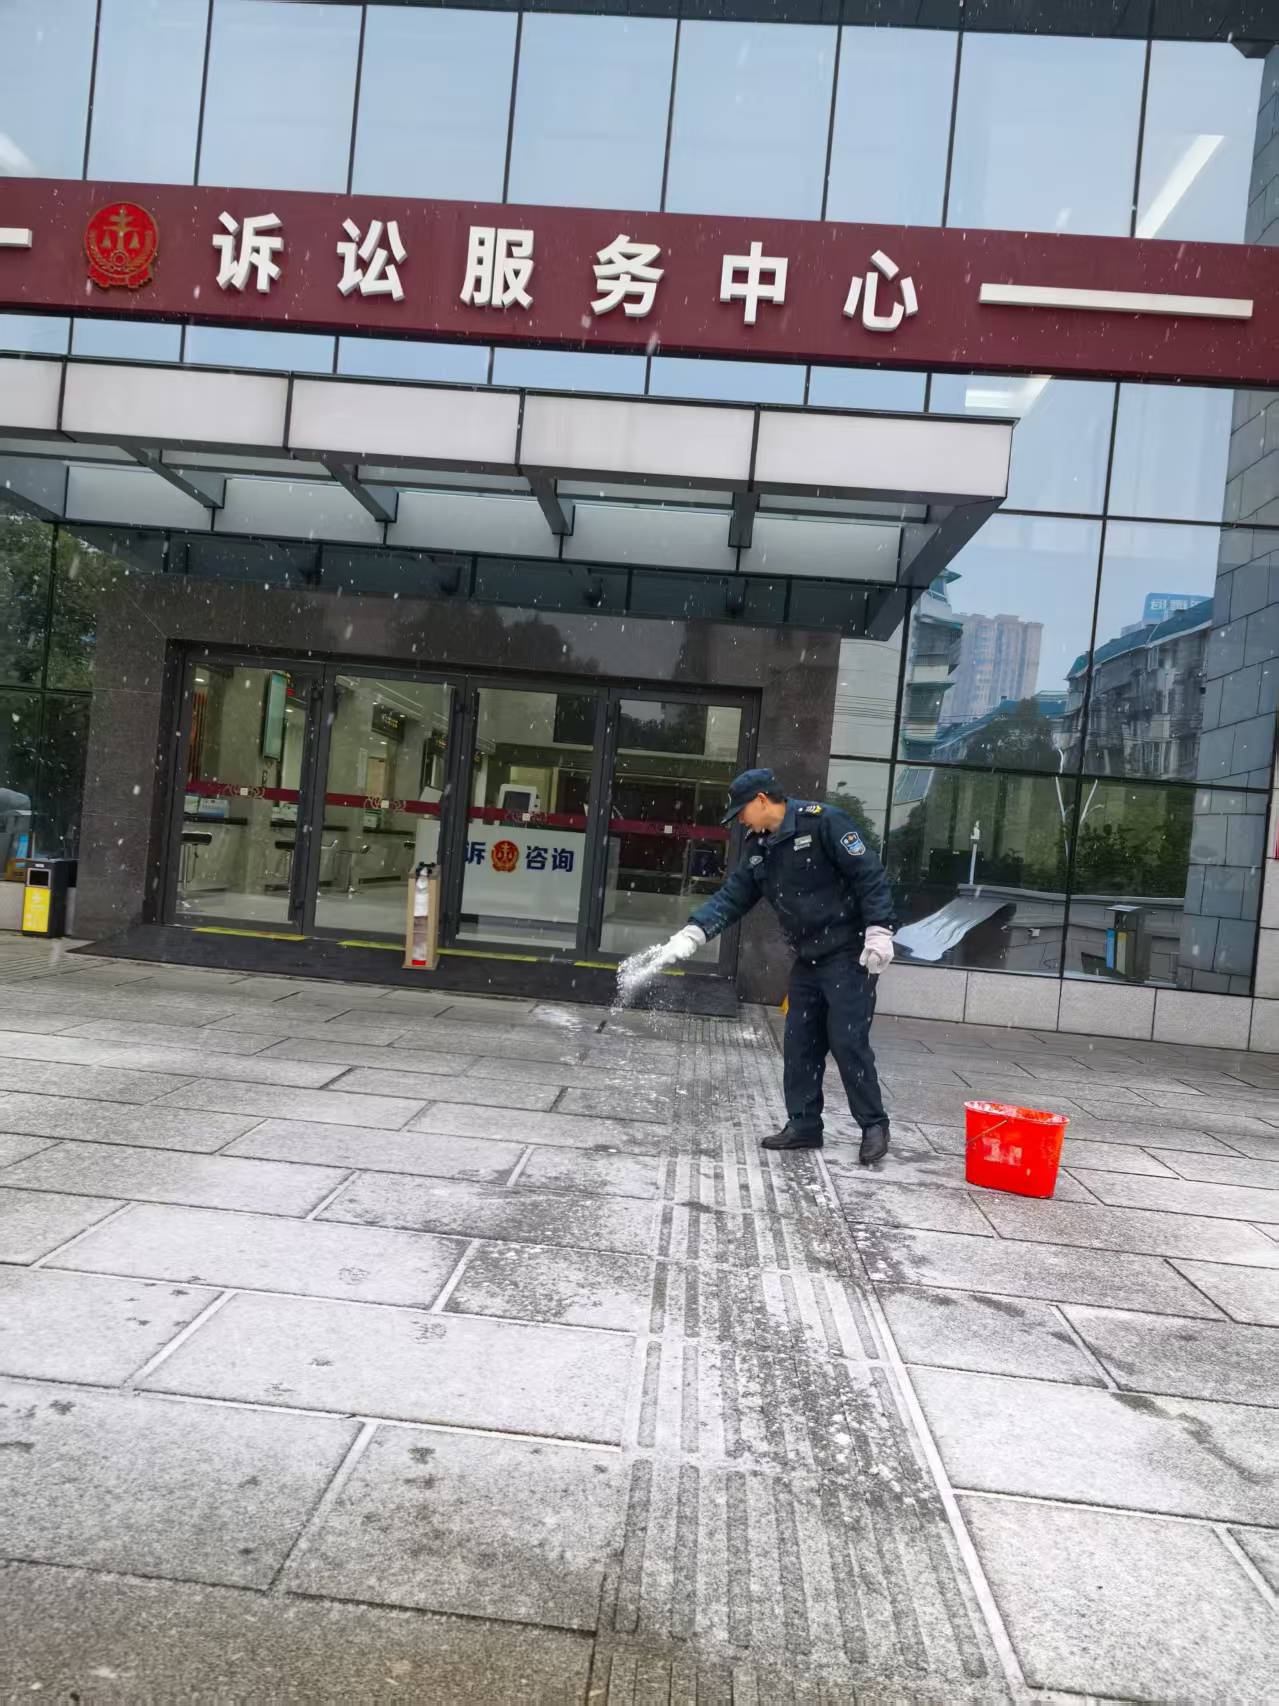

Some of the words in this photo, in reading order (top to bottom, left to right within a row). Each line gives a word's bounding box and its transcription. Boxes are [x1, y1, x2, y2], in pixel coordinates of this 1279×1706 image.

[212, 211, 919, 333] 诉讼服务中心
[525, 845, 575, 872] 咨询
